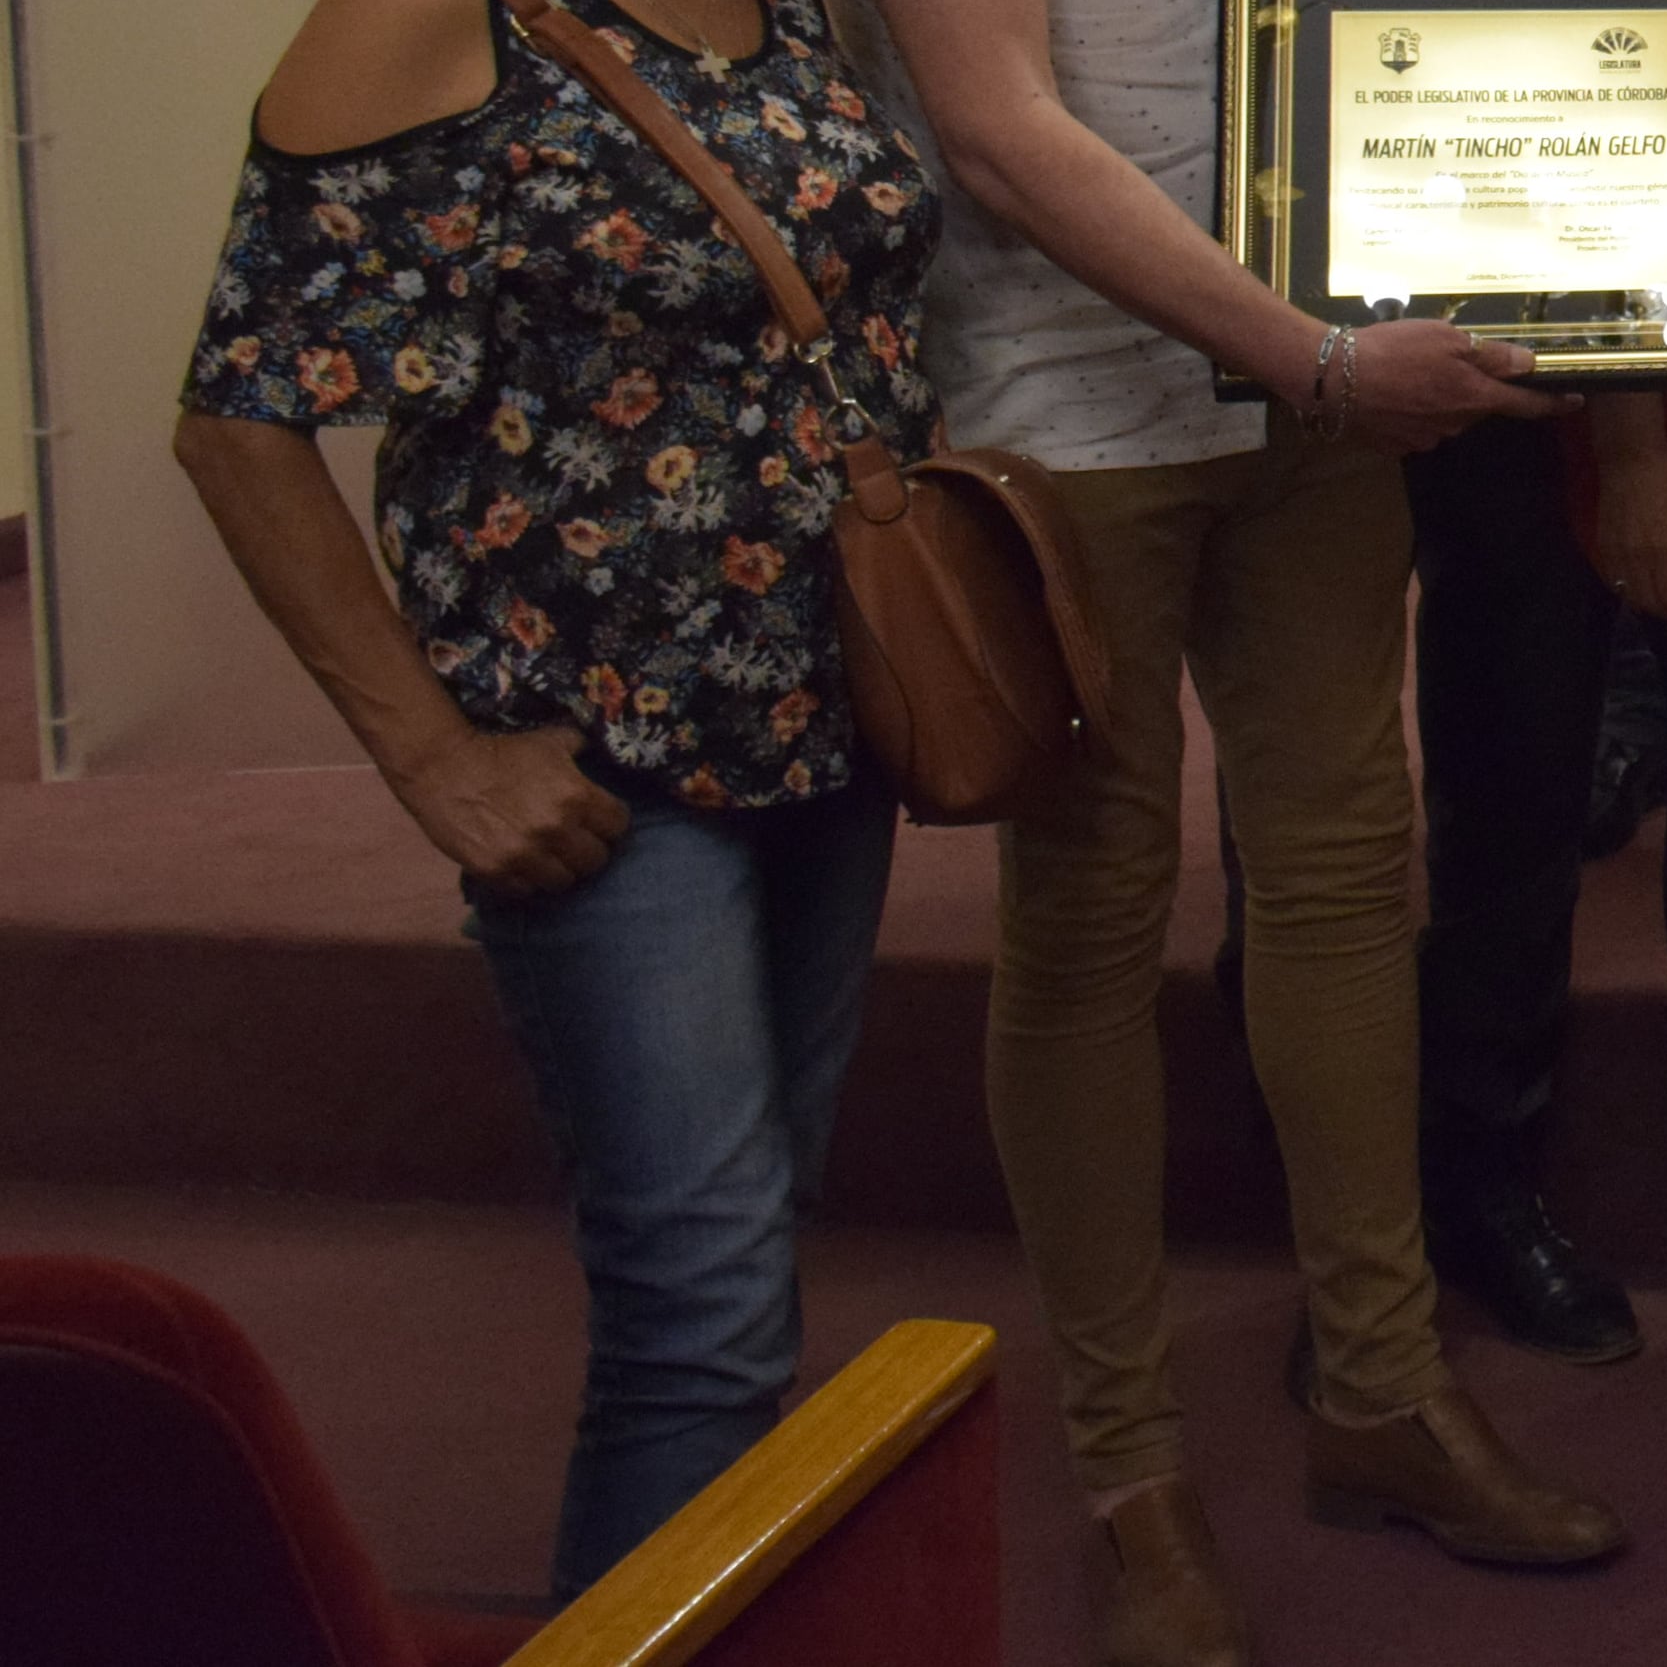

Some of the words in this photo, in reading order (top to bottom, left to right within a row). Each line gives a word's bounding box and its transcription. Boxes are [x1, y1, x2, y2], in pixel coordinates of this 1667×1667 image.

[1355, 91, 1369, 104] EL
[1374, 90, 1413, 103] PODER
[1417, 90, 1489, 103] LEGISLATIVO
[1494, 90, 1508, 103] DE
[1514, 89, 1528, 102] LA
[1533, 89, 1594, 102] PROVINCIA
[1598, 88, 1612, 101] DE
[1466, 115, 1478, 123] En
[1481, 114, 1556, 124] reconocimiento
[1362, 134, 1436, 159] MARTÍN
[1538, 132, 1600, 157] ROLÁN
[1608, 134, 1666, 156] GELFO
